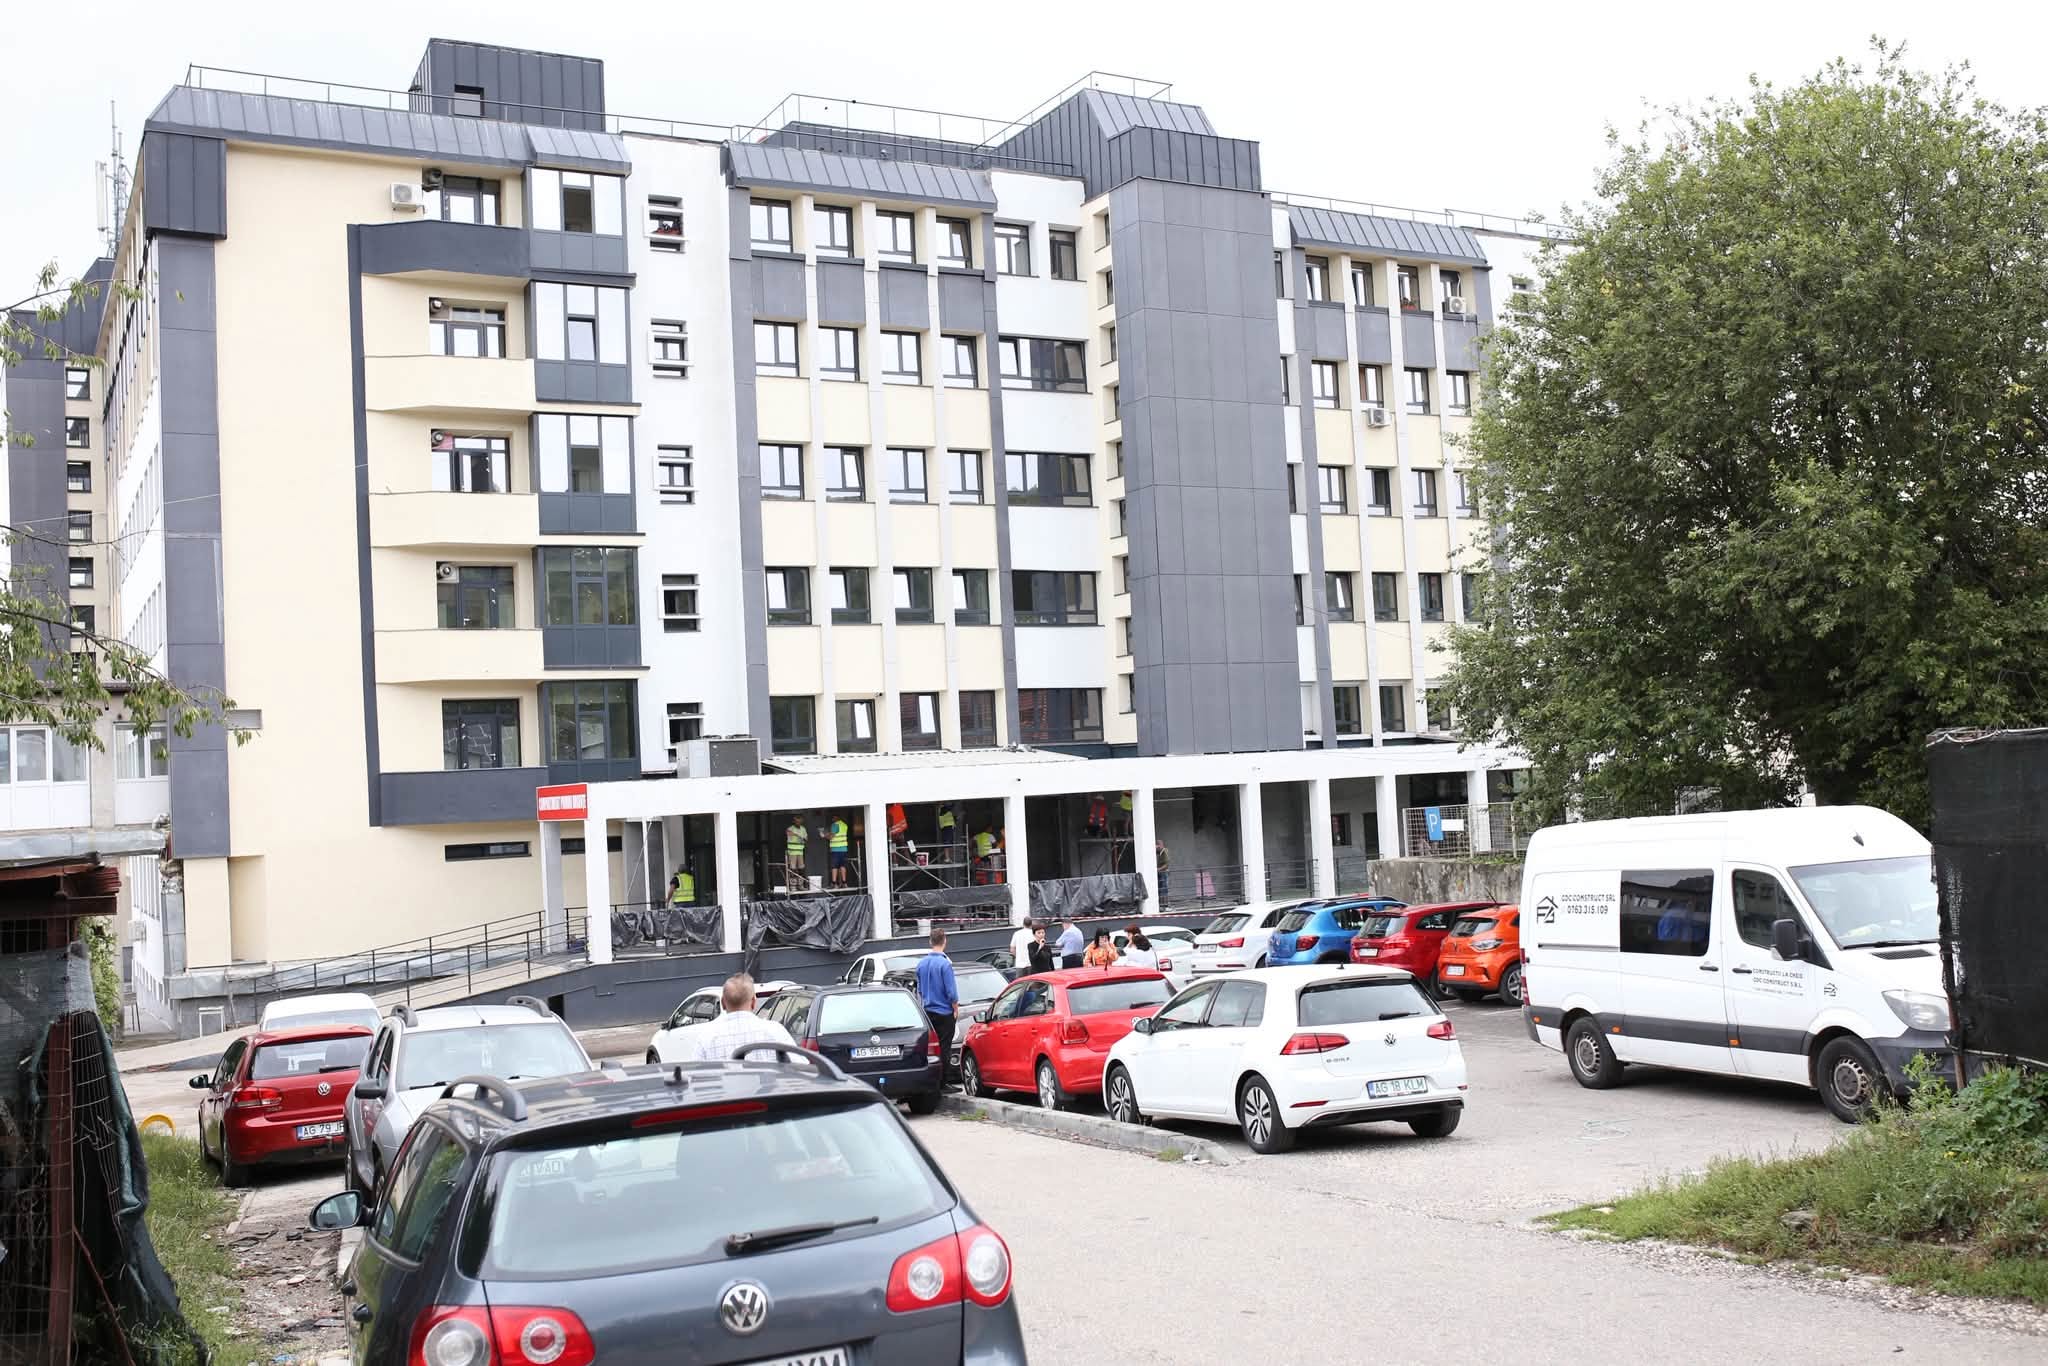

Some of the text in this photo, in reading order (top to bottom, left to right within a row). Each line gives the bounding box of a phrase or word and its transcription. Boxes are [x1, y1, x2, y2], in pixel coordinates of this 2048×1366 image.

[1429, 813, 1438, 833] P
[1572, 894, 1605, 902] CONSTRUCT
[1375, 1082, 1388, 1094] AG
[1391, 1080, 1401, 1092] 18
[1404, 1078, 1424, 1091] KLM
[303, 1125, 316, 1136] AG
[319, 1123, 331, 1134] 79
